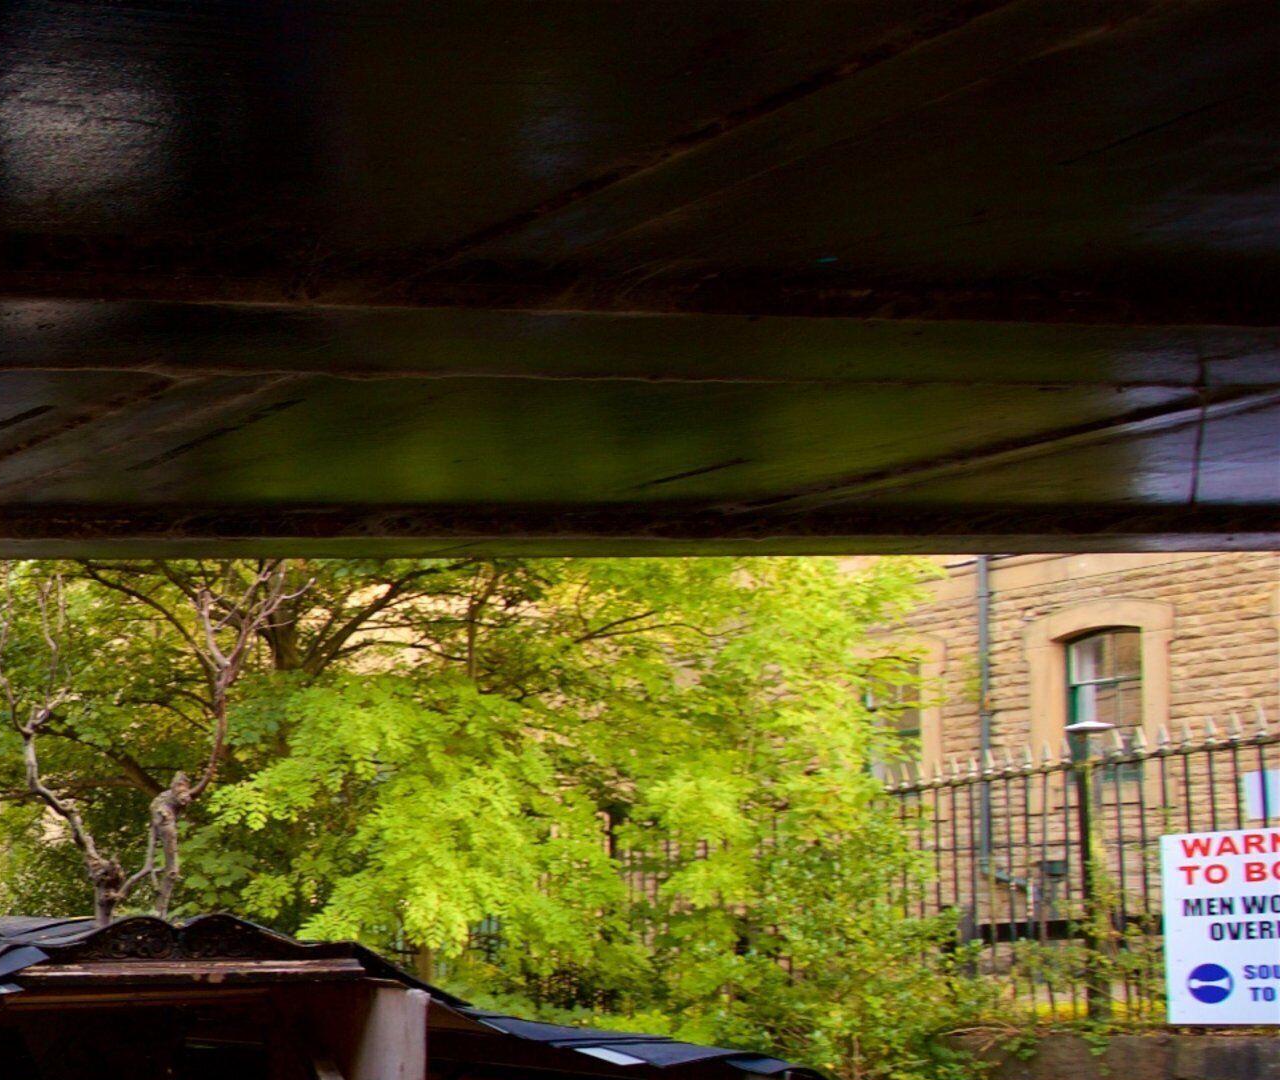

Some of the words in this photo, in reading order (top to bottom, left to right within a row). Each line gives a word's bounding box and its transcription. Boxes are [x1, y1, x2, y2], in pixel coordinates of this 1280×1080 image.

[1179, 864, 1229, 885] TO
[1183, 897, 1234, 917] MEN
[1209, 921, 1280, 941] OVER
[1249, 986, 1276, 1001] TO
